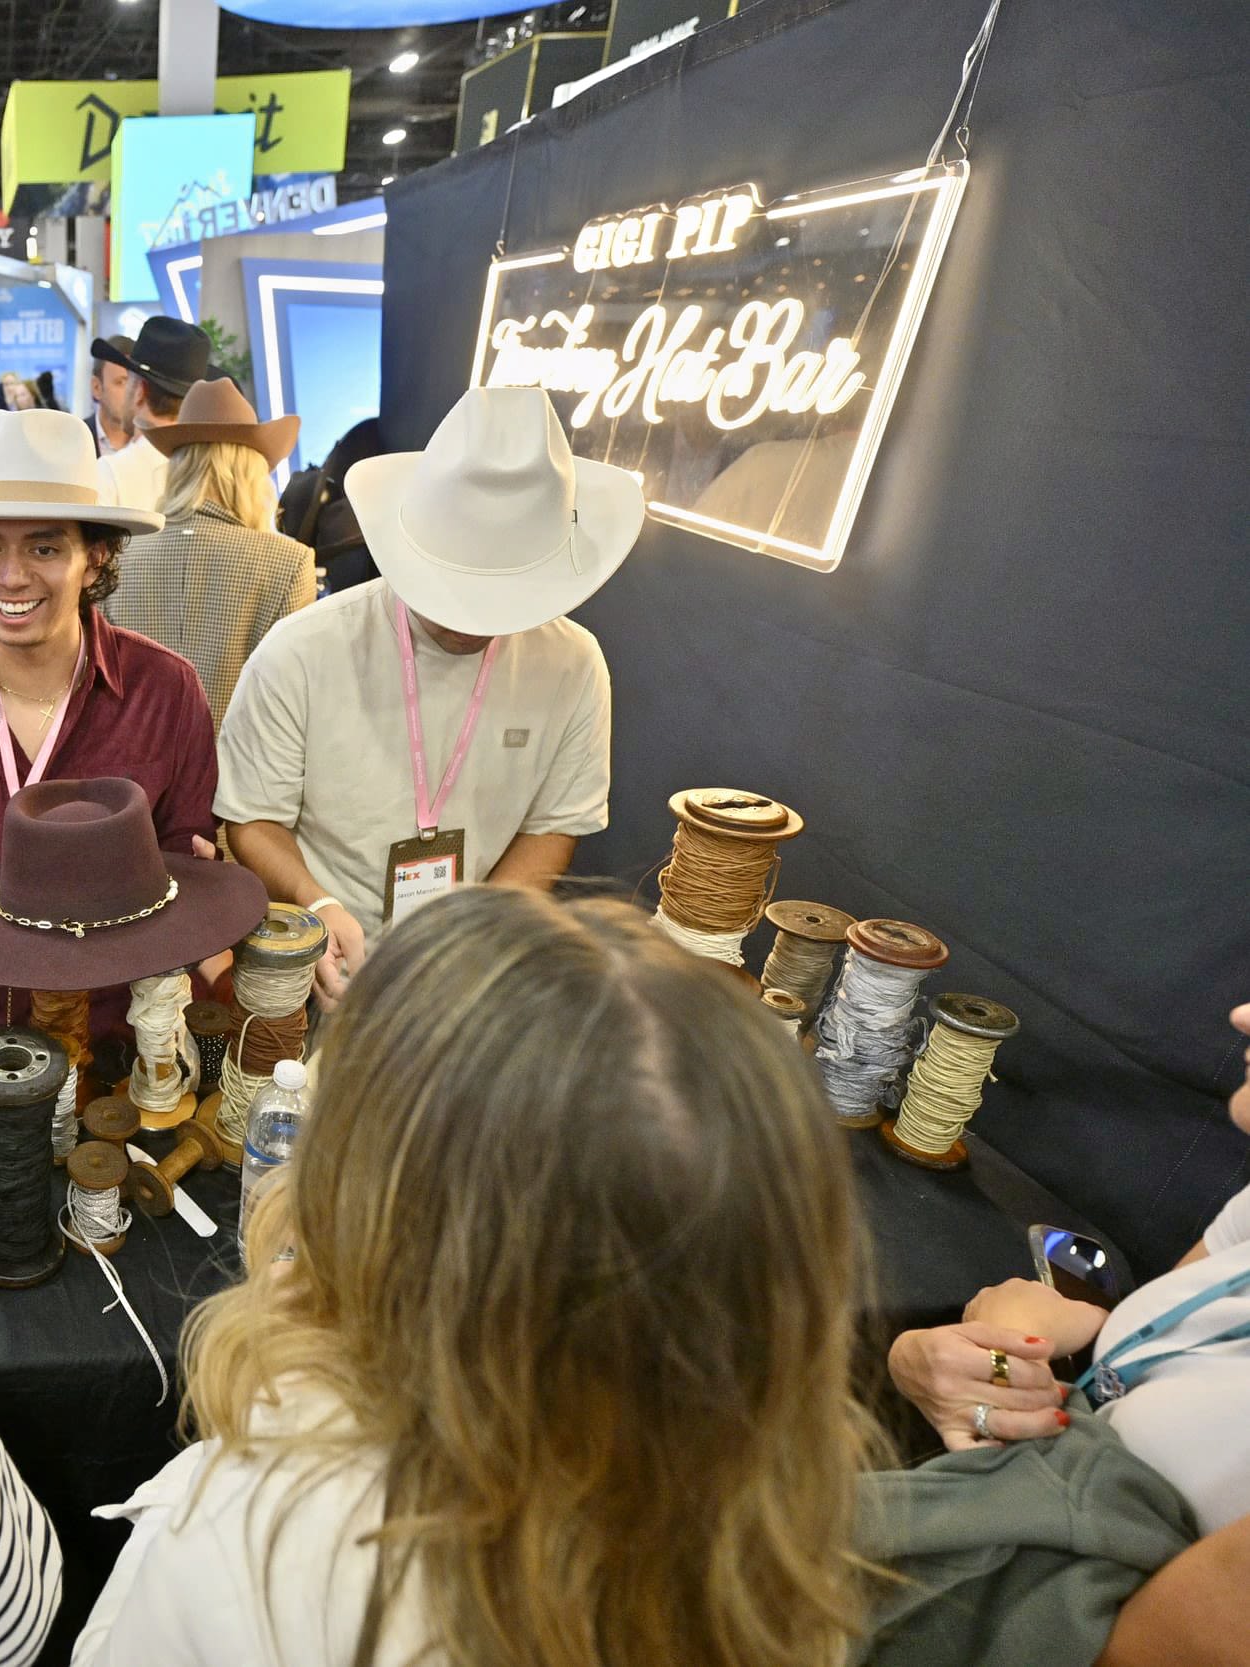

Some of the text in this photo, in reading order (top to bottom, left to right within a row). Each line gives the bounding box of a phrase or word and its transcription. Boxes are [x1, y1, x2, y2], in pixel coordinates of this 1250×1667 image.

[573, 194, 752, 274] GIGI PIP
[603, 304, 726, 424] Hat
[706, 298, 866, 430] Bar
